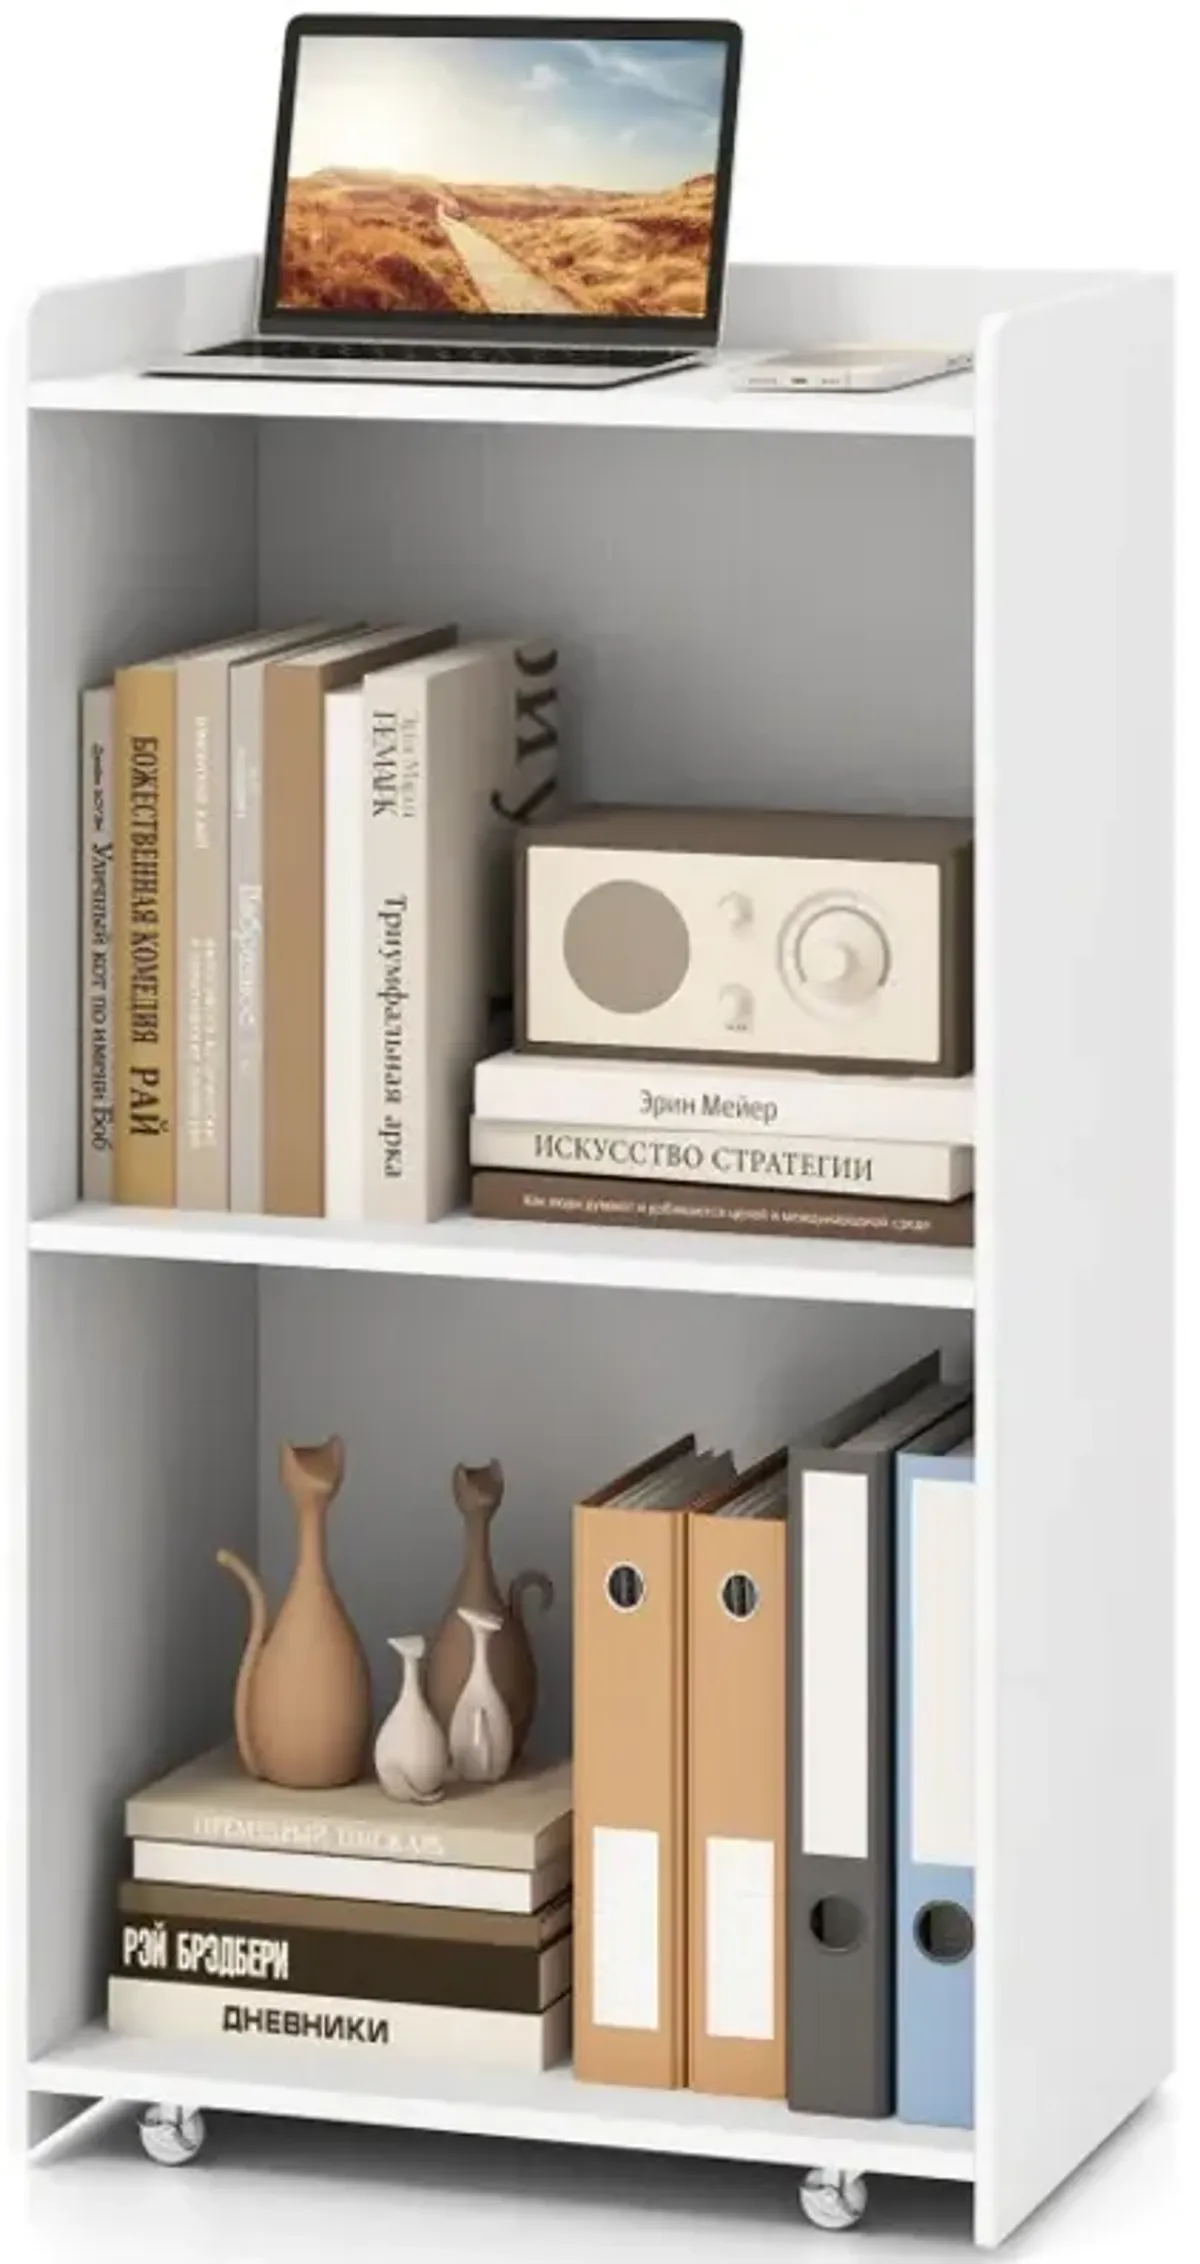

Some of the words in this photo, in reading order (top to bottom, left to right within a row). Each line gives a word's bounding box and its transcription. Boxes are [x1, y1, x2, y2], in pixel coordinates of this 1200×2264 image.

[130, 735, 159, 924] БОЖЕСТВЕННАЯ
[91, 952, 107, 989] кот
[130, 931, 159, 1044] КОМЕДИЯ
[91, 996, 107, 1025] по
[377, 896, 410, 1104] Триумфальная
[91, 1104, 114, 1151] Боб
[129, 1065, 170, 1137] РАЙ
[639, 1088, 696, 1120] Эрин
[701, 1093, 779, 1126] Мейер
[377, 1113, 403, 1179] арка
[533, 1133, 704, 1169] ИСКУССТВО
[710, 1146, 874, 1182] СТРАТЕГИИ
[122, 1920, 168, 1969] РЭЙ
[176, 1930, 289, 1981] БРЭДБЕРИ
[221, 2004, 390, 2044] ДНЕВНИКИ
